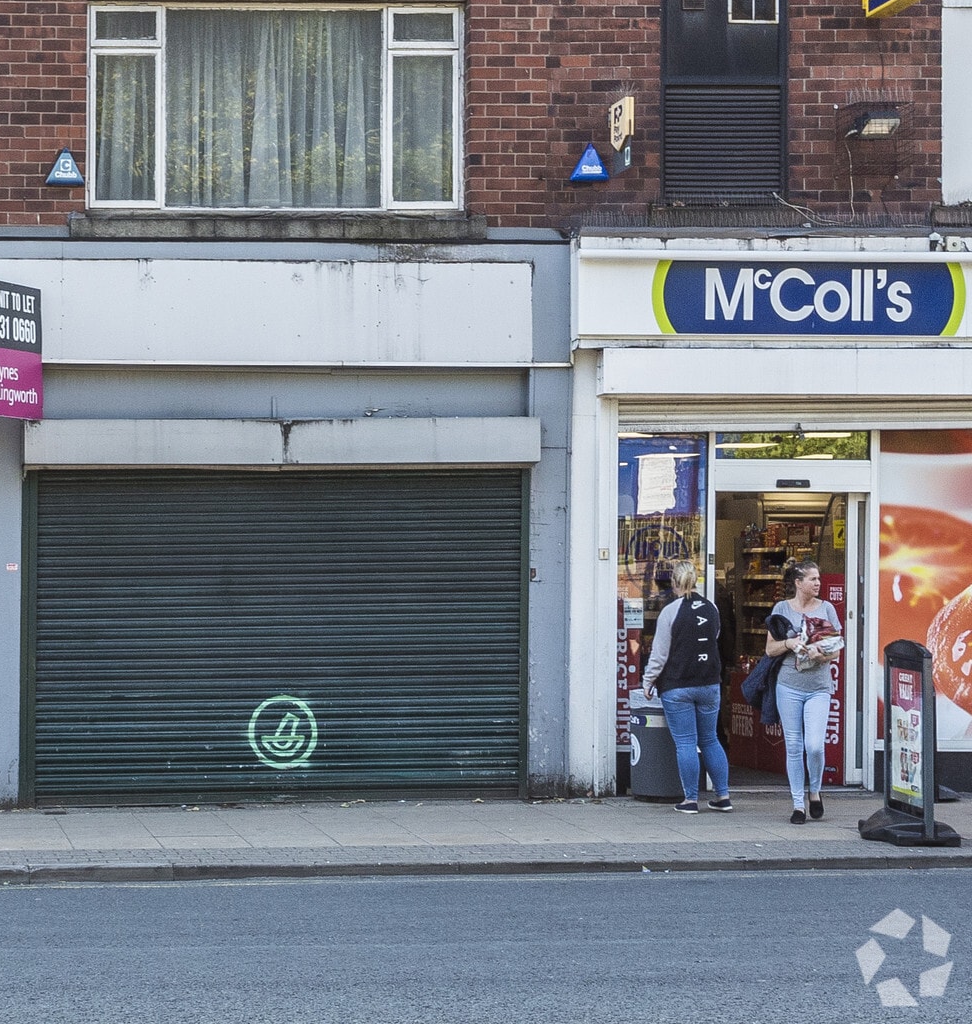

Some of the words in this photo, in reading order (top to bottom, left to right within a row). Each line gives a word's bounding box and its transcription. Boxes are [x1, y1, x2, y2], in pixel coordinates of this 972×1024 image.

[11, 291, 21, 310] TO
[22, 293, 35, 314] LET
[704, 267, 913, 322] McColl's
[12, 317, 36, 344] 0660
[829, 591, 843, 601] CUTS
[732, 703, 754, 715] SPECIAL
[732, 714, 754, 737] OFFERS
